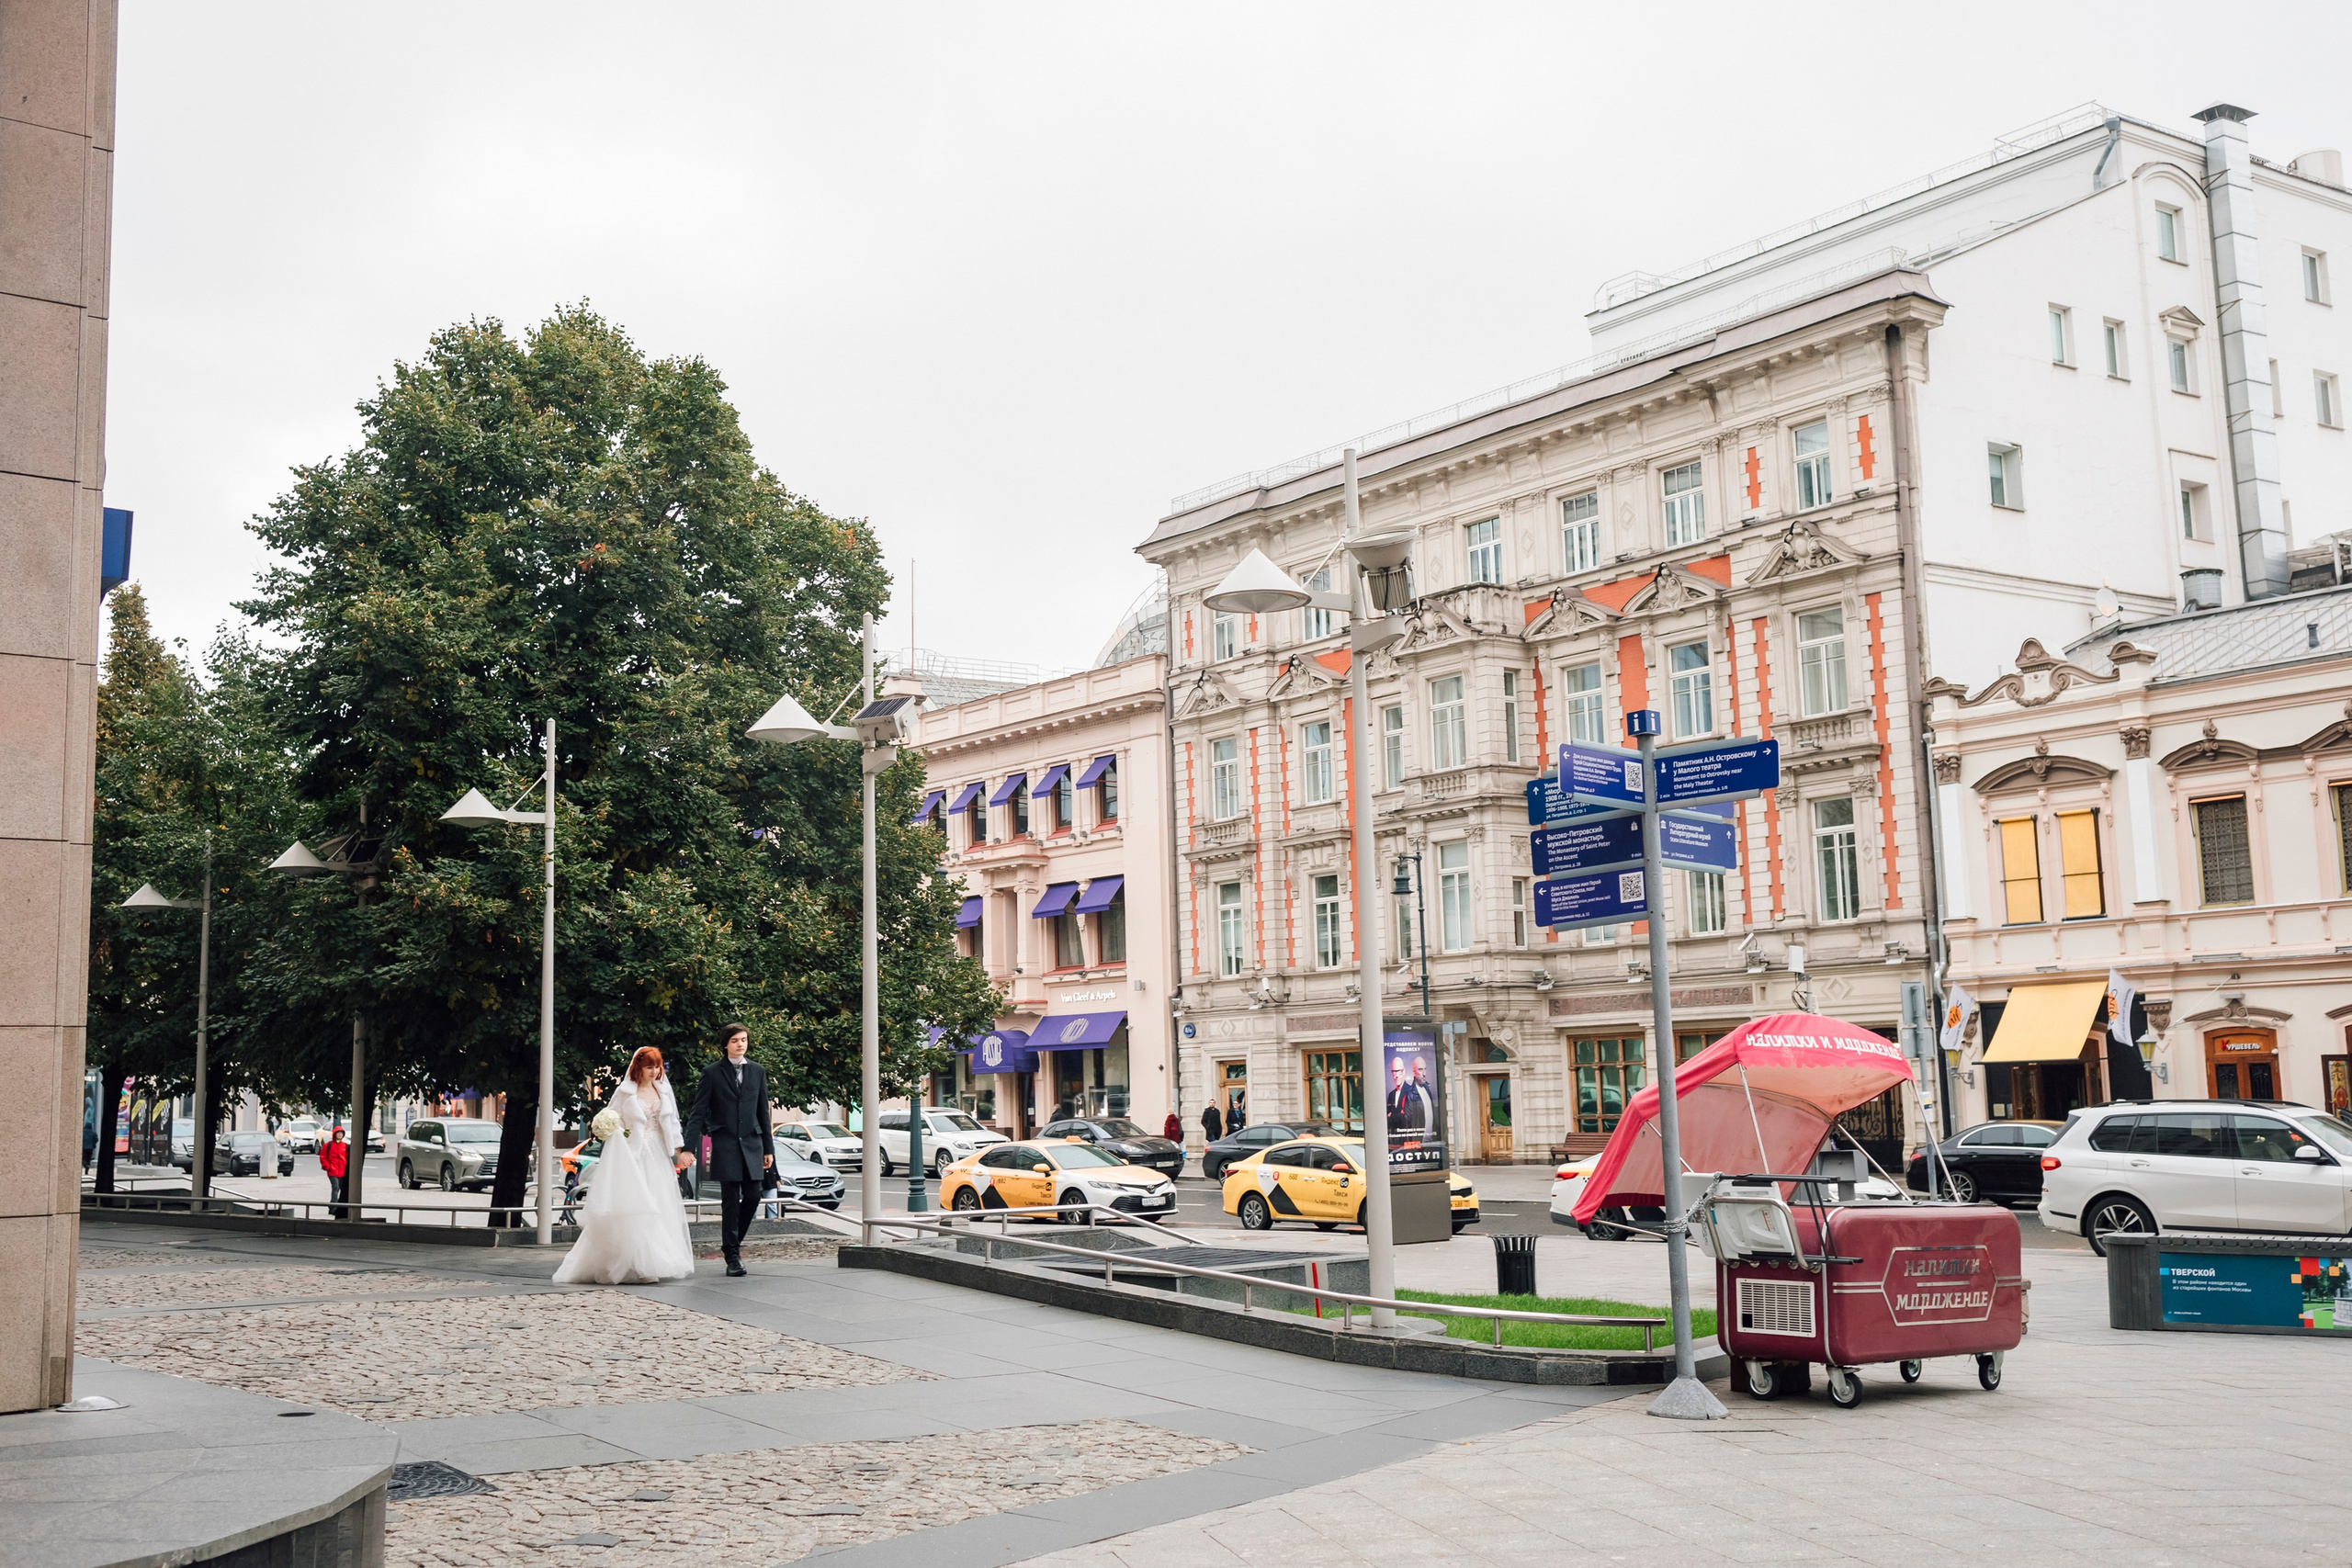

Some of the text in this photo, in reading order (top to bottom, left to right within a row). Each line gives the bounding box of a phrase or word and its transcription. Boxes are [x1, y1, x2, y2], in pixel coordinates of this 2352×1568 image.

[1673, 759, 1703, 767] Памятник
[1716, 750, 1756, 761] Островскому
[1669, 821, 1704, 832] Государственный
[1547, 826, 1603, 841] Высоко-Петровский
[1670, 828, 1698, 838] Литературный
[1547, 835, 1604, 849] мужской монастырь
[1556, 846, 1580, 854] Monastery
[1060, 989, 1116, 1002] Van Cleef & Arpels
[1321, 1177, 1339, 1185] Яндекс
[2170, 1268, 2216, 1277] ТВЕРСКОЙ
